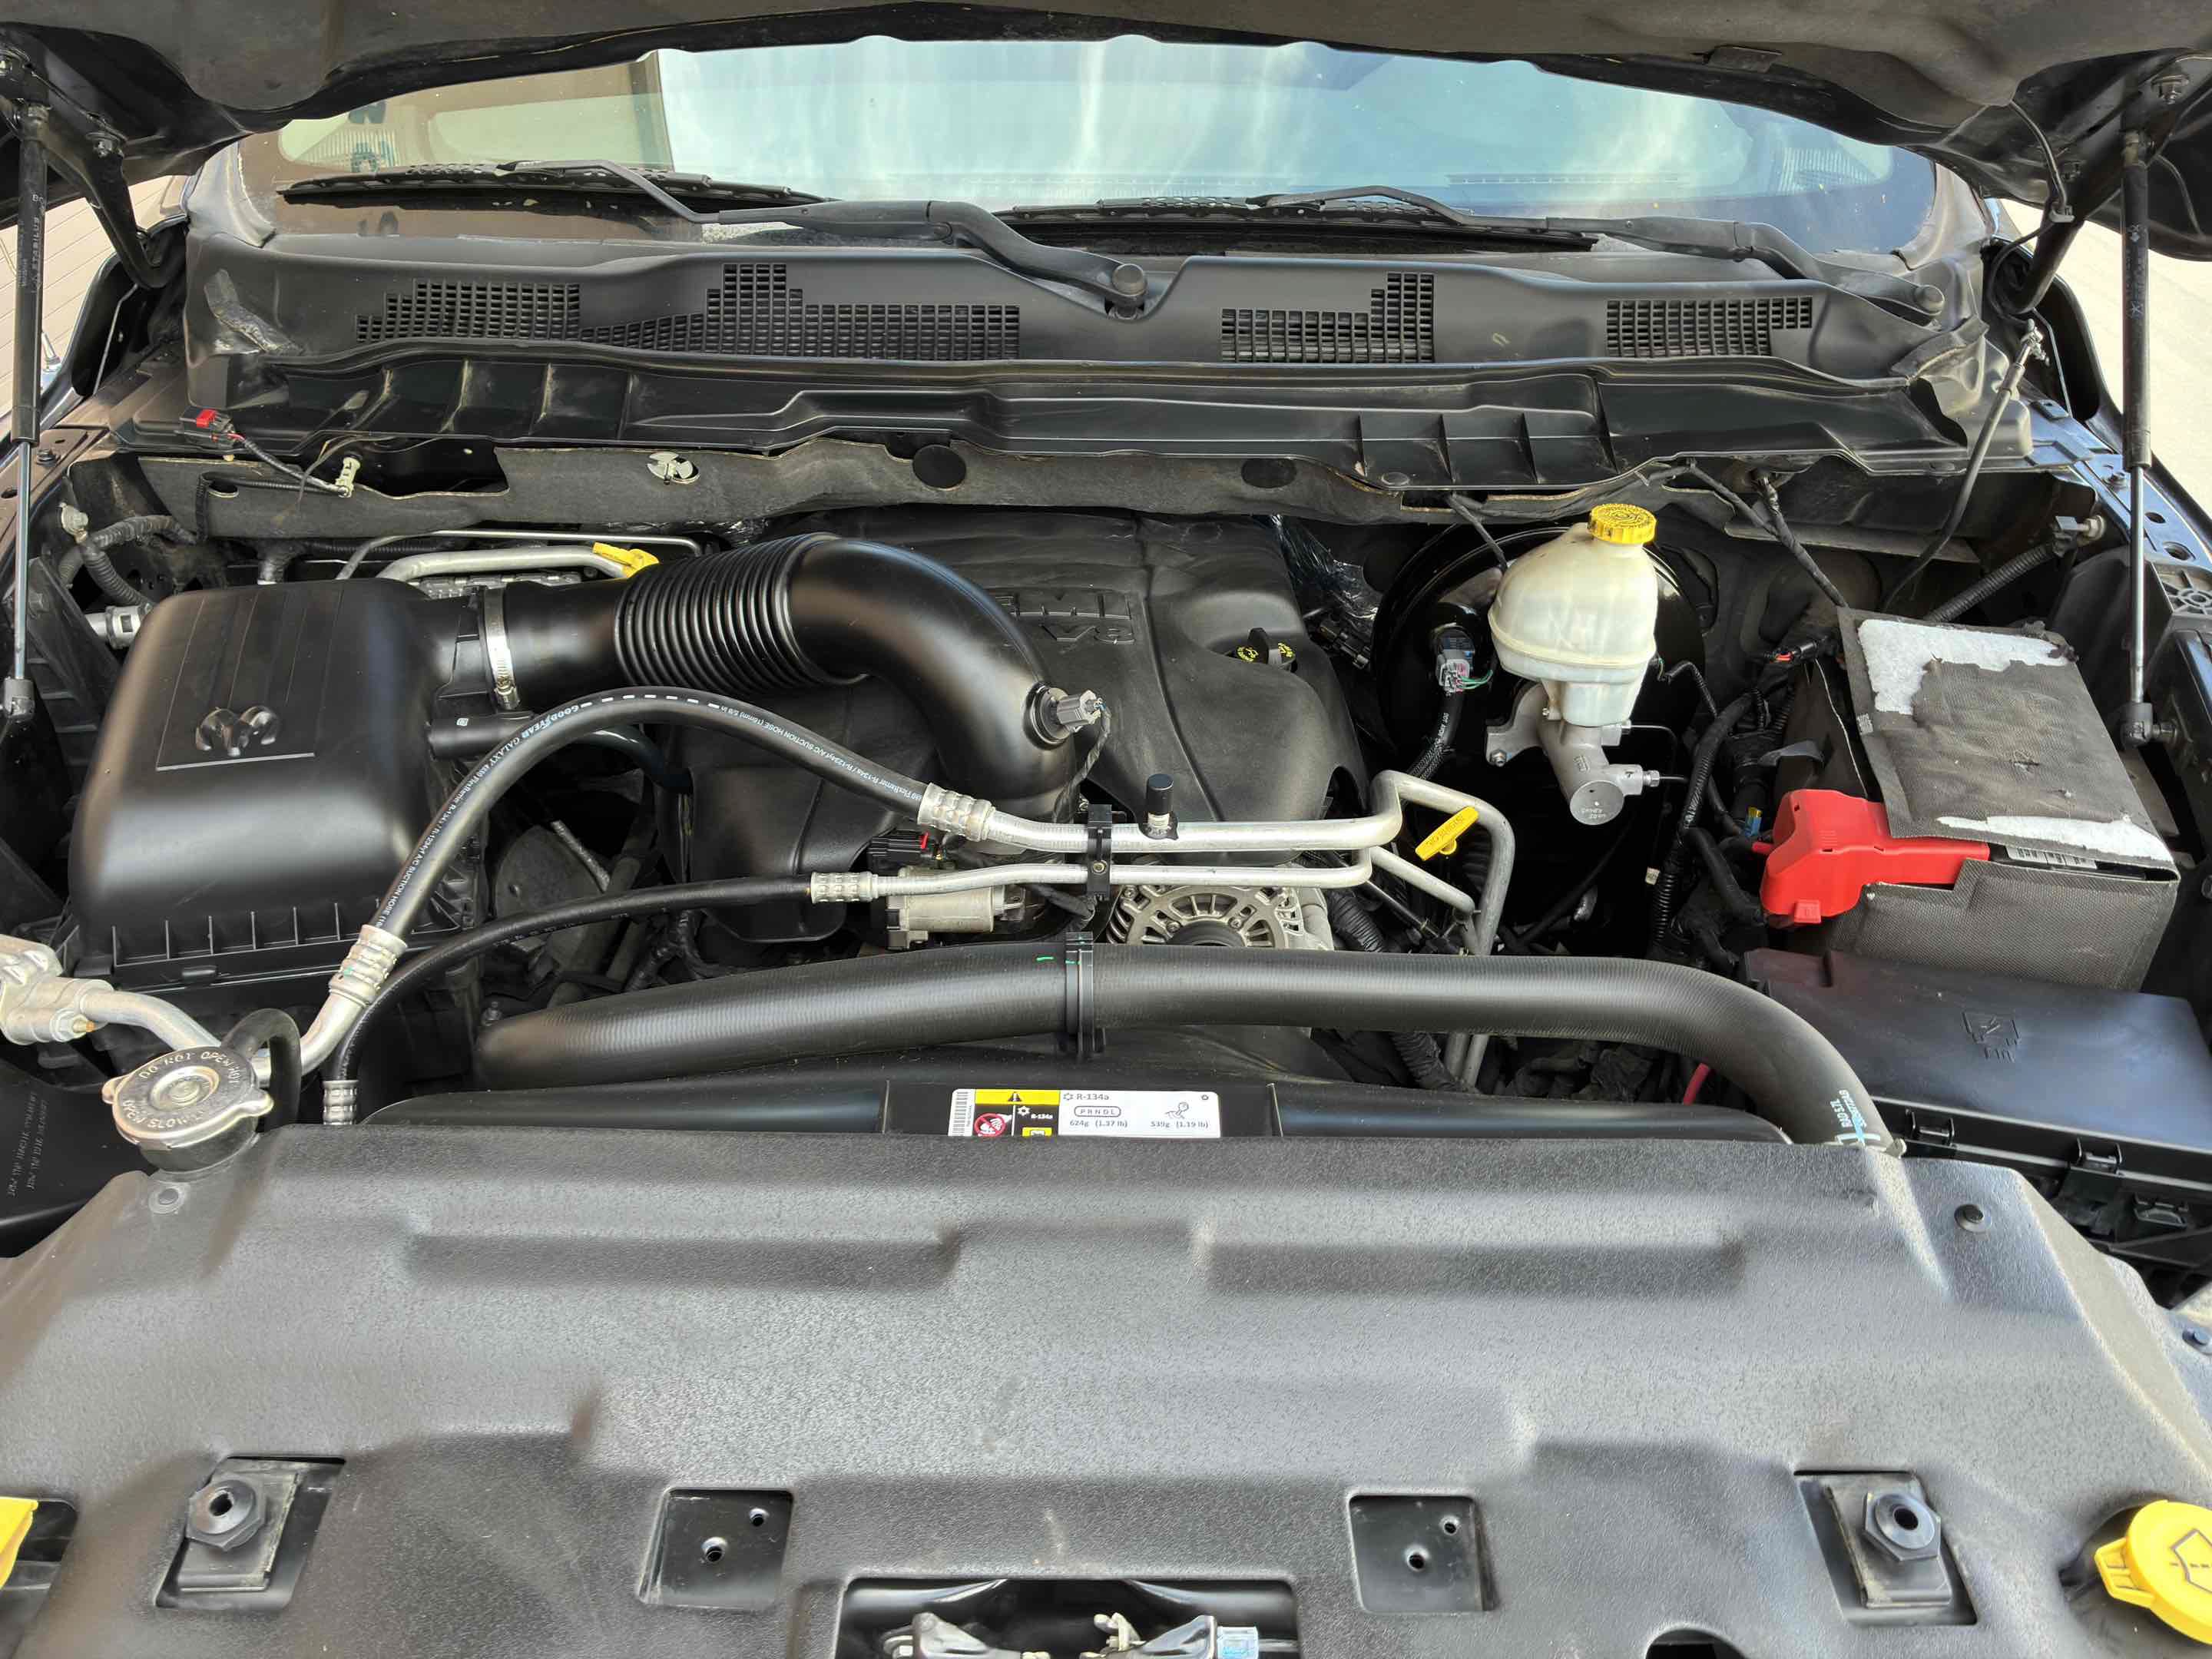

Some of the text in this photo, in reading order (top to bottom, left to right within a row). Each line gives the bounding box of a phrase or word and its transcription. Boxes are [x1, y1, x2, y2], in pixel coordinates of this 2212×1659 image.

[522, 704, 578, 739] GOODYEAR
[763, 722, 783, 735] HOSE
[488, 737, 520, 765] GALAXY
[783, 730, 814, 750] SUCTION
[394, 866, 416, 896] SUCTION
[139, 1066, 159, 1079] DO
[164, 1051, 196, 1065] NOT
[200, 1051, 233, 1068] OPEN
[123, 1099, 147, 1124] OPEN
